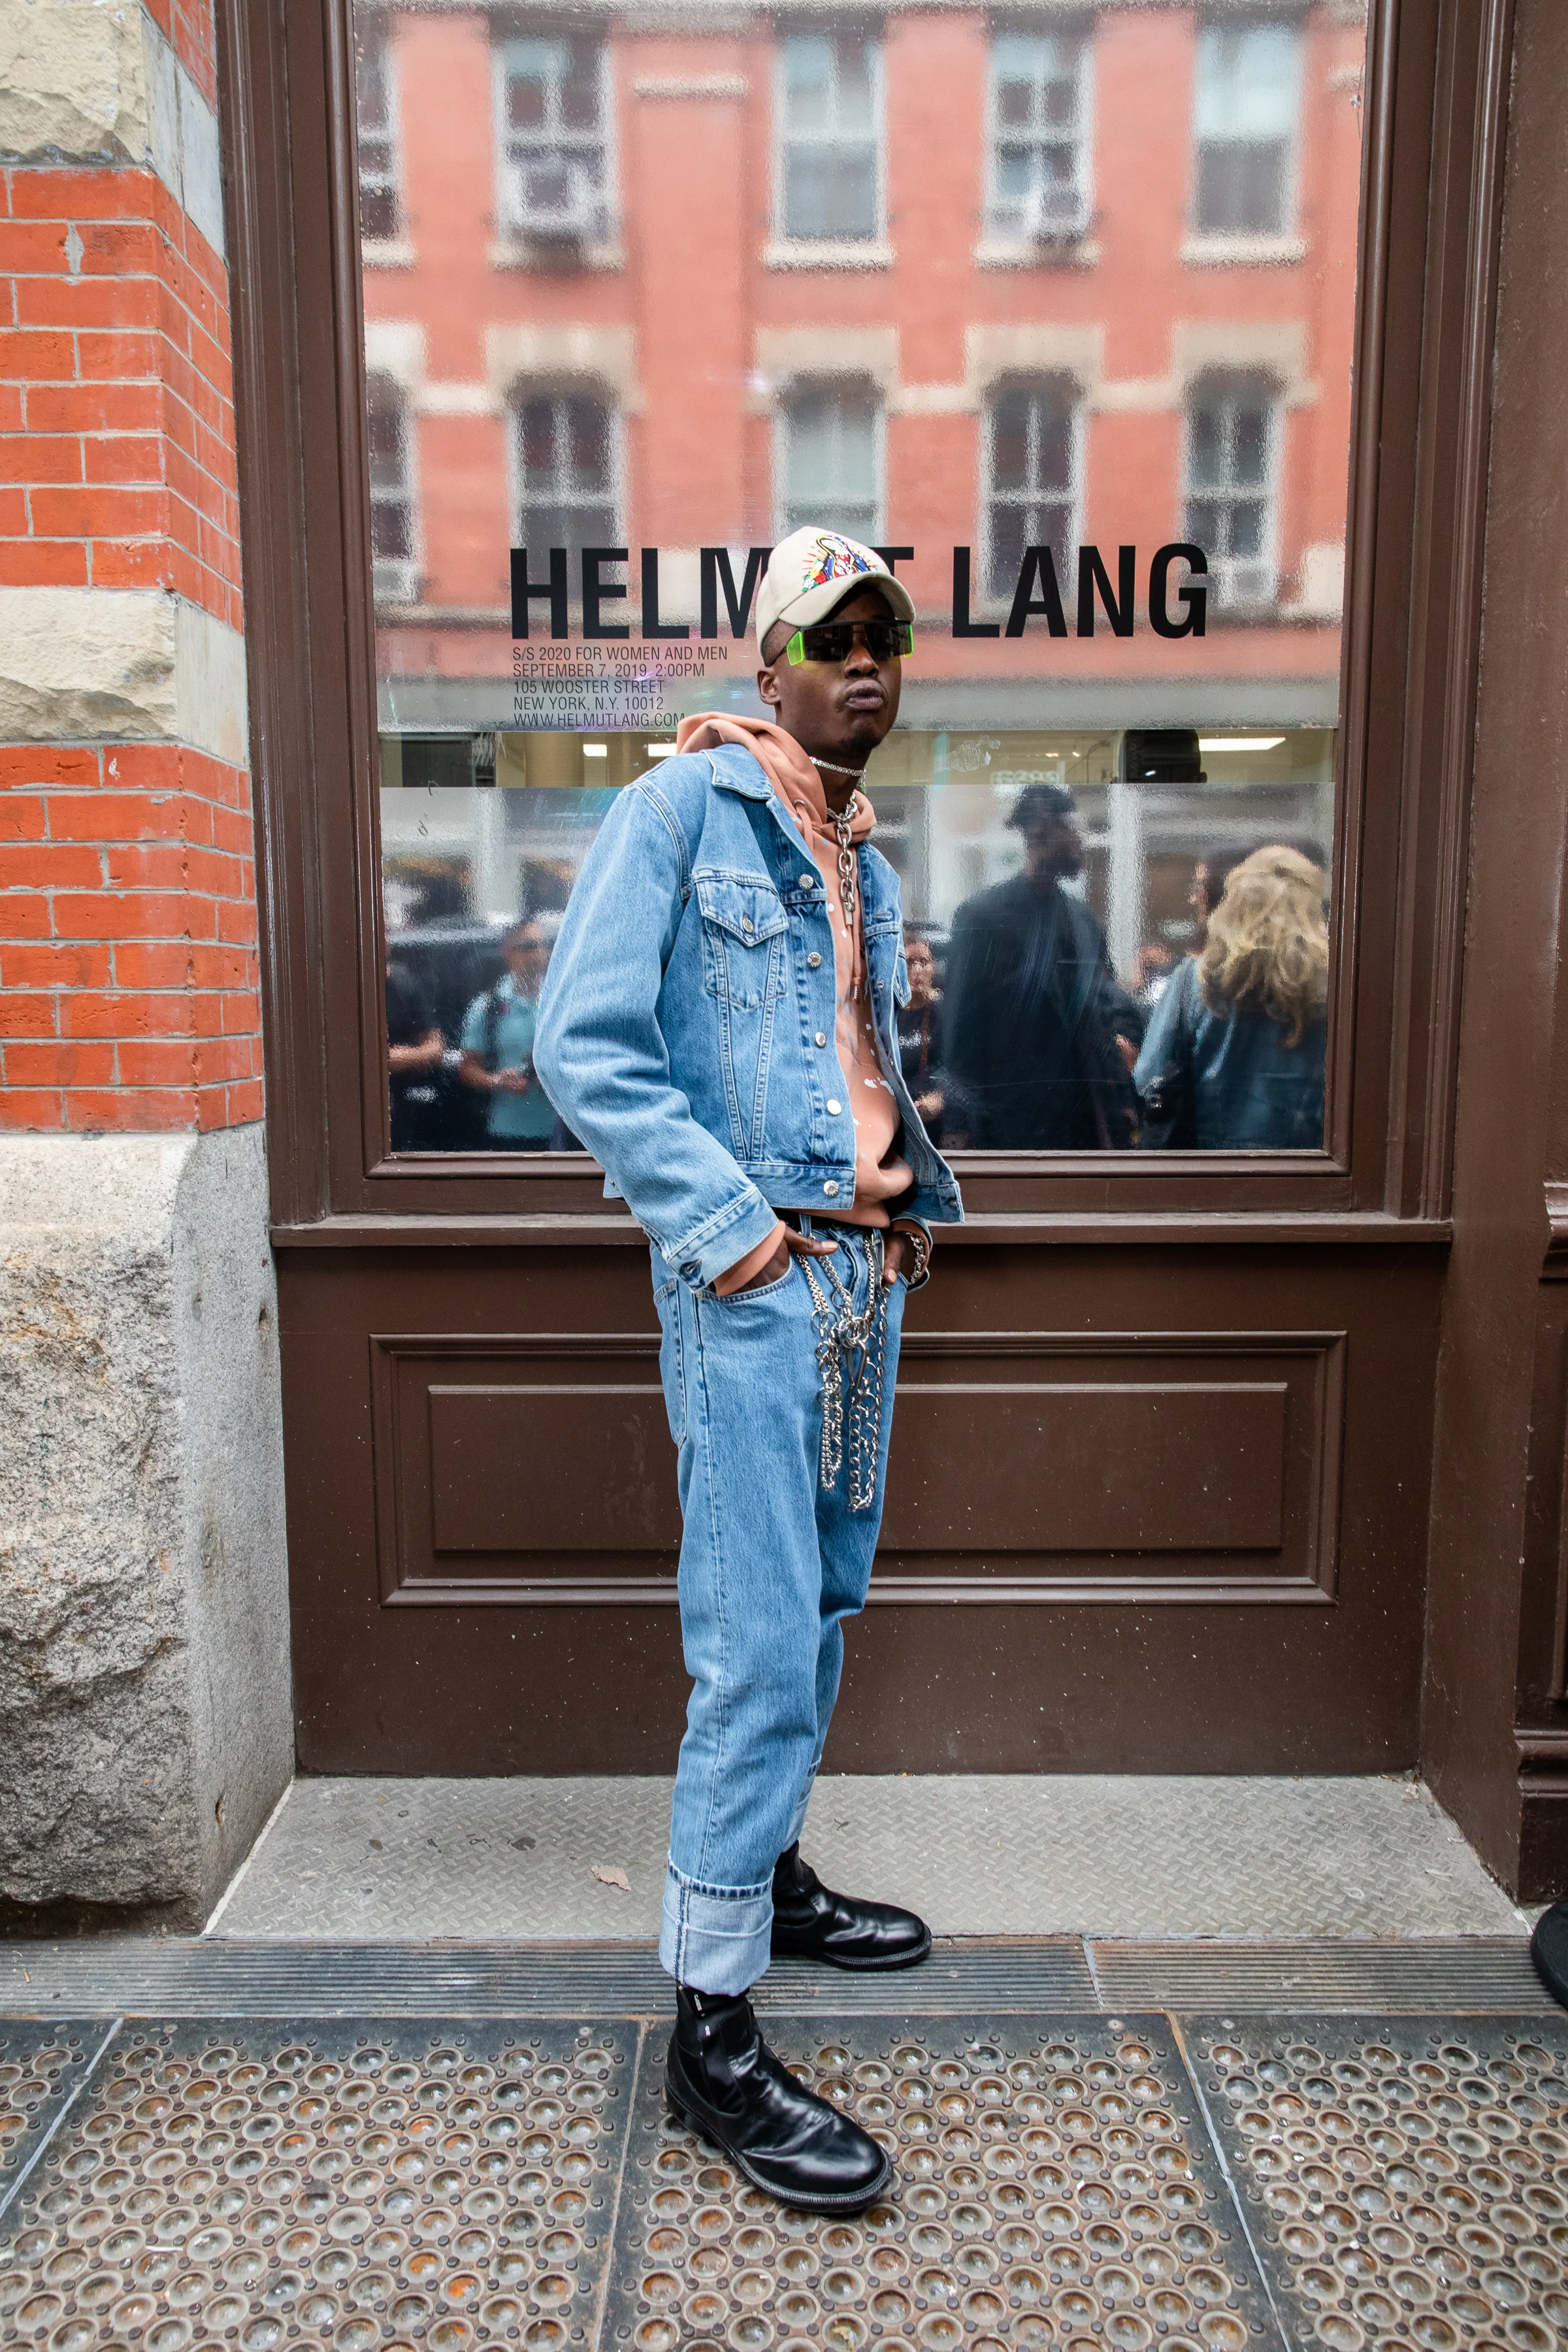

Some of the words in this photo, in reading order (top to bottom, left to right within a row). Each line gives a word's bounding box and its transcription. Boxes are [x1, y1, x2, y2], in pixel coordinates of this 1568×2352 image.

[511, 547, 913, 639] HELM
[953, 544, 1207, 639] LANG
[513, 646, 534, 661] S/S
[539, 646, 571, 661] 2020
[576, 646, 602, 661] FOR
[607, 646, 660, 661] WOMEN
[665, 646, 693, 661] AND
[698, 646, 727, 661] MEN
[513, 663, 594, 678] SEPTEMBER
[599, 664, 610, 679] 7,
[615, 663, 647, 677] 2019
[656, 663, 704, 677] 2:00PM
[515, 680, 536, 694] 105
[542, 679, 610, 694] WOOSTER
[614, 679, 664, 694] STREET
[514, 696, 544, 710] NEW
[549, 696, 590, 712] YORK,
[595, 696, 619, 710] N.Y.
[625, 696, 664, 710] 10012
[514, 713, 685, 727] WWW.HELMUTLANG.COM
